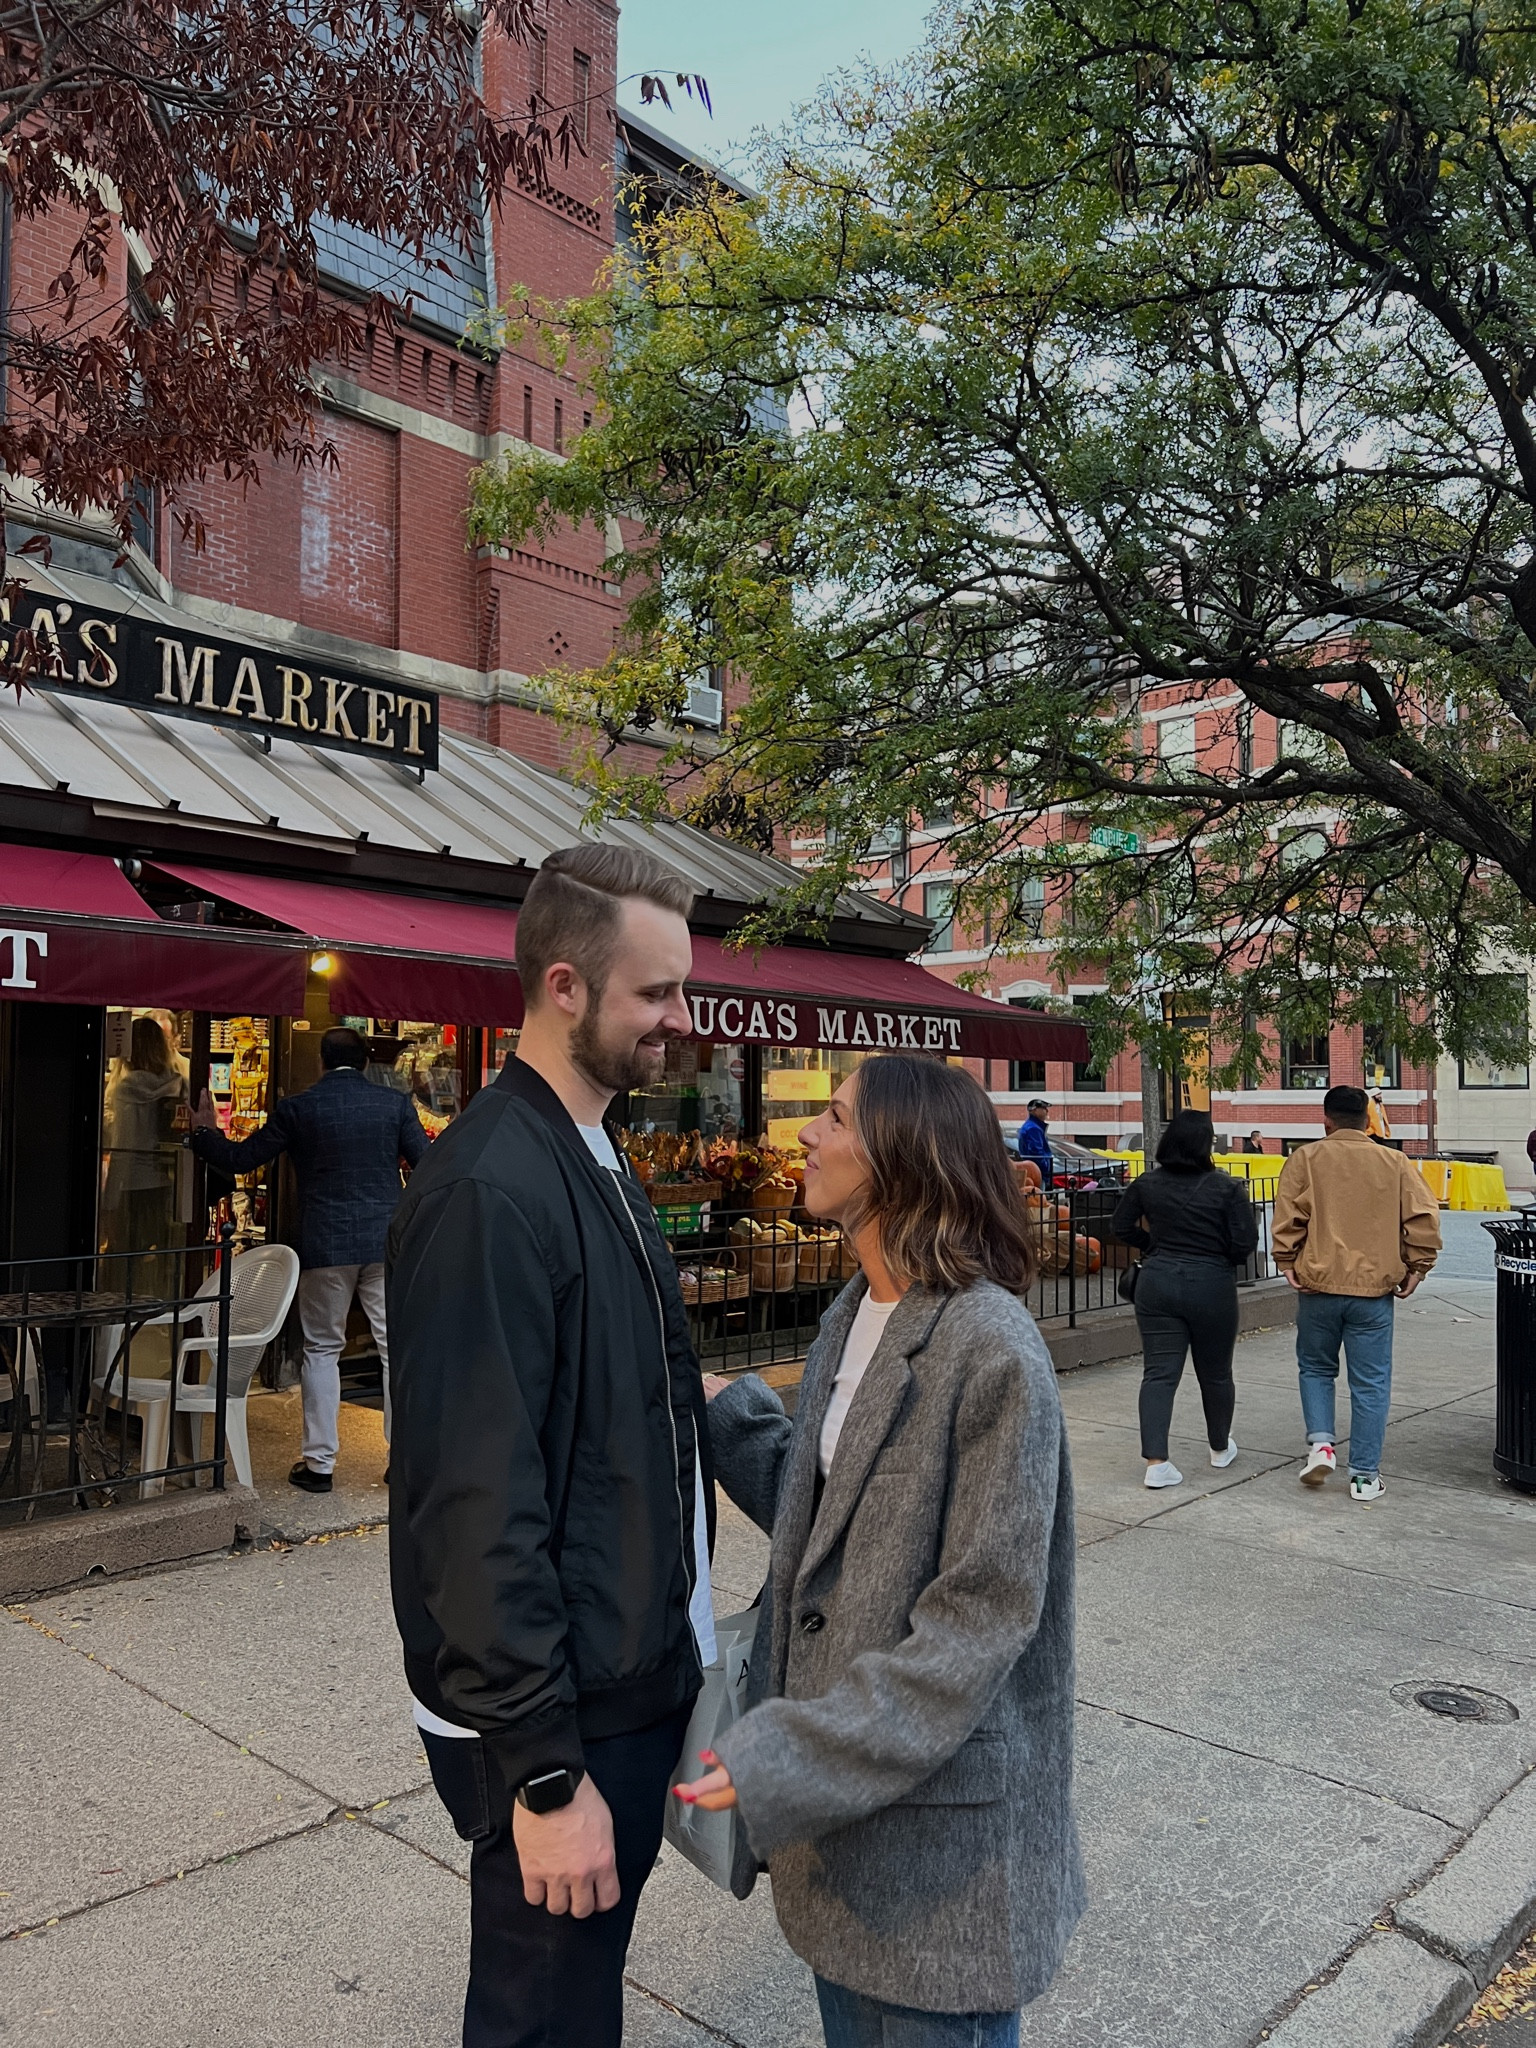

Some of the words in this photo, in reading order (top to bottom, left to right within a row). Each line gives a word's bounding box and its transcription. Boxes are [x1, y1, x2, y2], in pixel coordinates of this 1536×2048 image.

[0, 597, 118, 688] A'S
[154, 636, 431, 757] MARKET
[816, 1007, 962, 1051] MARKET
[1500, 1255, 1536, 1272] Recycle
